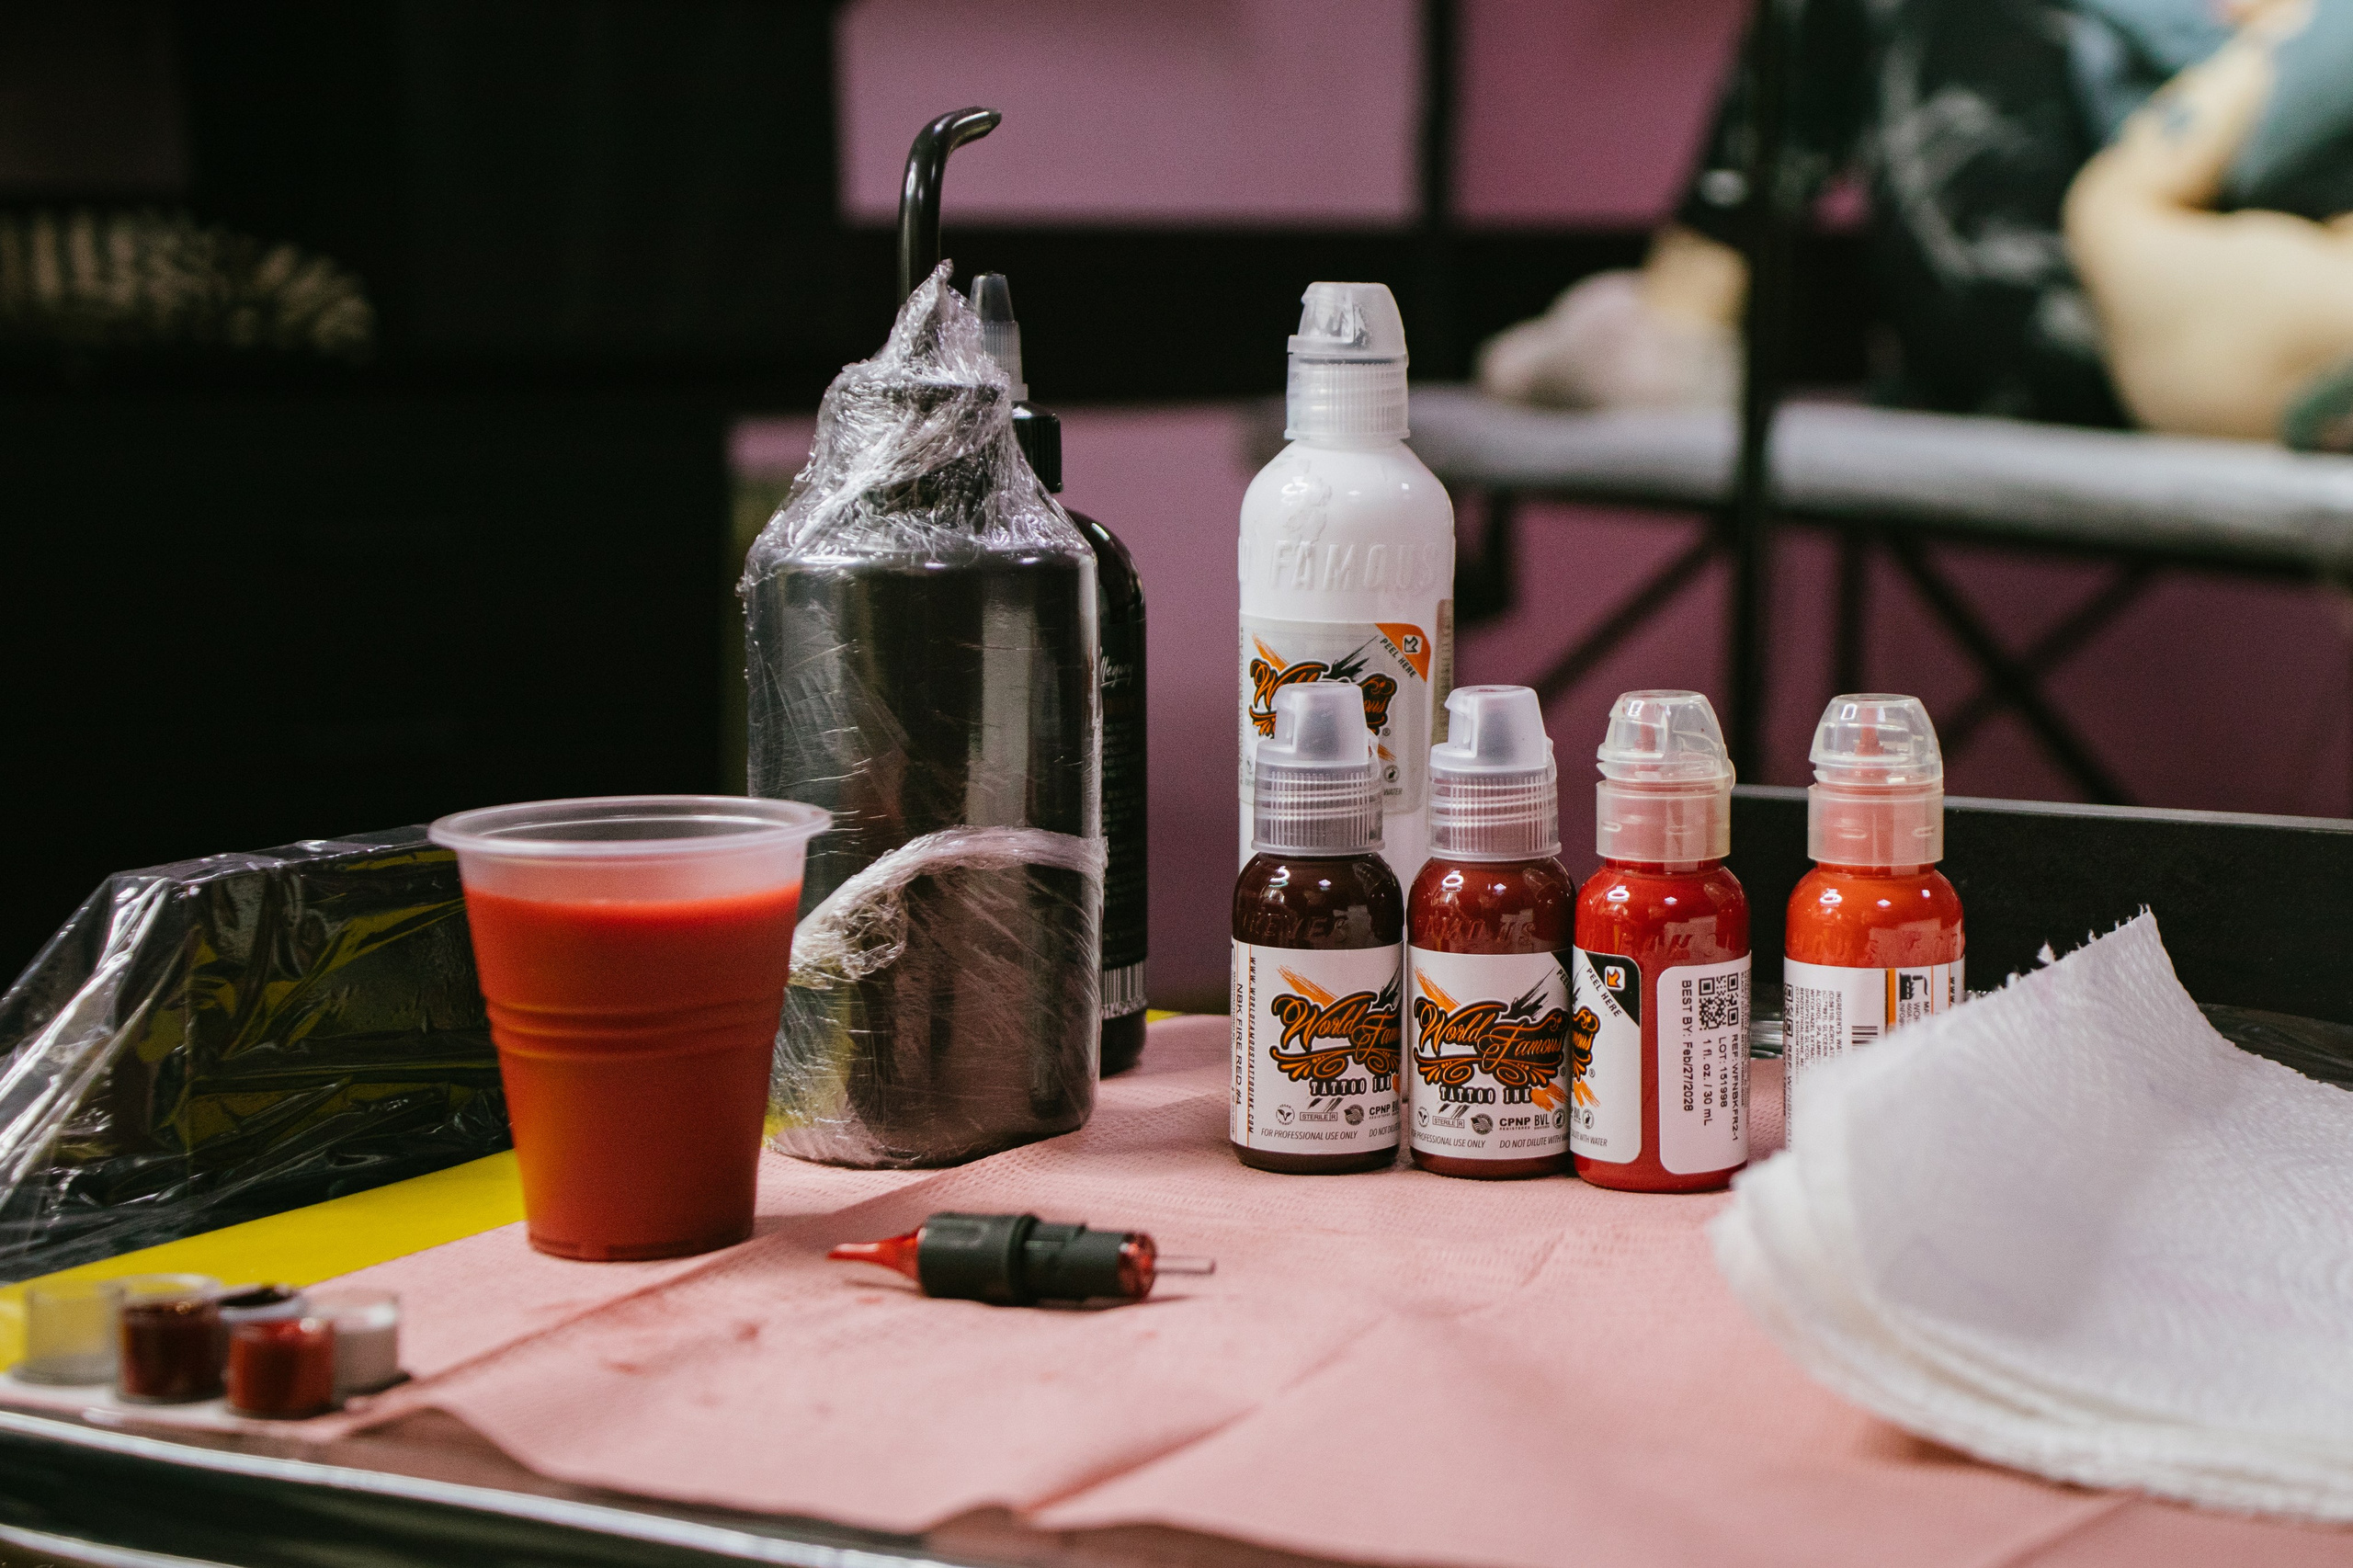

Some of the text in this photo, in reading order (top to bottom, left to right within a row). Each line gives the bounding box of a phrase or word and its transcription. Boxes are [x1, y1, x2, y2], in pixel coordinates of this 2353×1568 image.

[1380, 638, 1416, 677] PEEL HERE
[1383, 787, 1403, 796] WATER
[1586, 968, 1622, 1017] PEEL HERE
[1273, 994, 1376, 1050] World
[1415, 999, 1507, 1055] World
[1682, 980, 1693, 1111] BEST BY: Feb/27/2028
[1703, 1050, 1711, 1060] fl.
[1311, 1080, 1367, 1096] TATTOO
[1440, 1087, 1531, 1102] TATTOO INK
[1236, 1089, 1242, 1105] #4
[1703, 1091, 1712, 1104] 30
[1370, 1104, 1391, 1115] CPNP
[1704, 1108, 1712, 1126] mL
[1499, 1117, 1530, 1126] CPNP
[1534, 1114, 1550, 1126] BVL
[1261, 1128, 1358, 1140] FOR PROFESSIONAL USE ONLY
[1370, 1129, 1377, 1137] DO
[1416, 1131, 1451, 1146] PROFESSIONAL
[1453, 1139, 1465, 1147] USE
[1467, 1139, 1485, 1148] ONLY
[1499, 1140, 1510, 1148] DO
[1512, 1139, 1526, 1148] NOT
[1527, 1137, 1546, 1147] DILUTE
[1548, 1136, 1561, 1144] WITH
[1590, 1136, 1608, 1146] WATER
